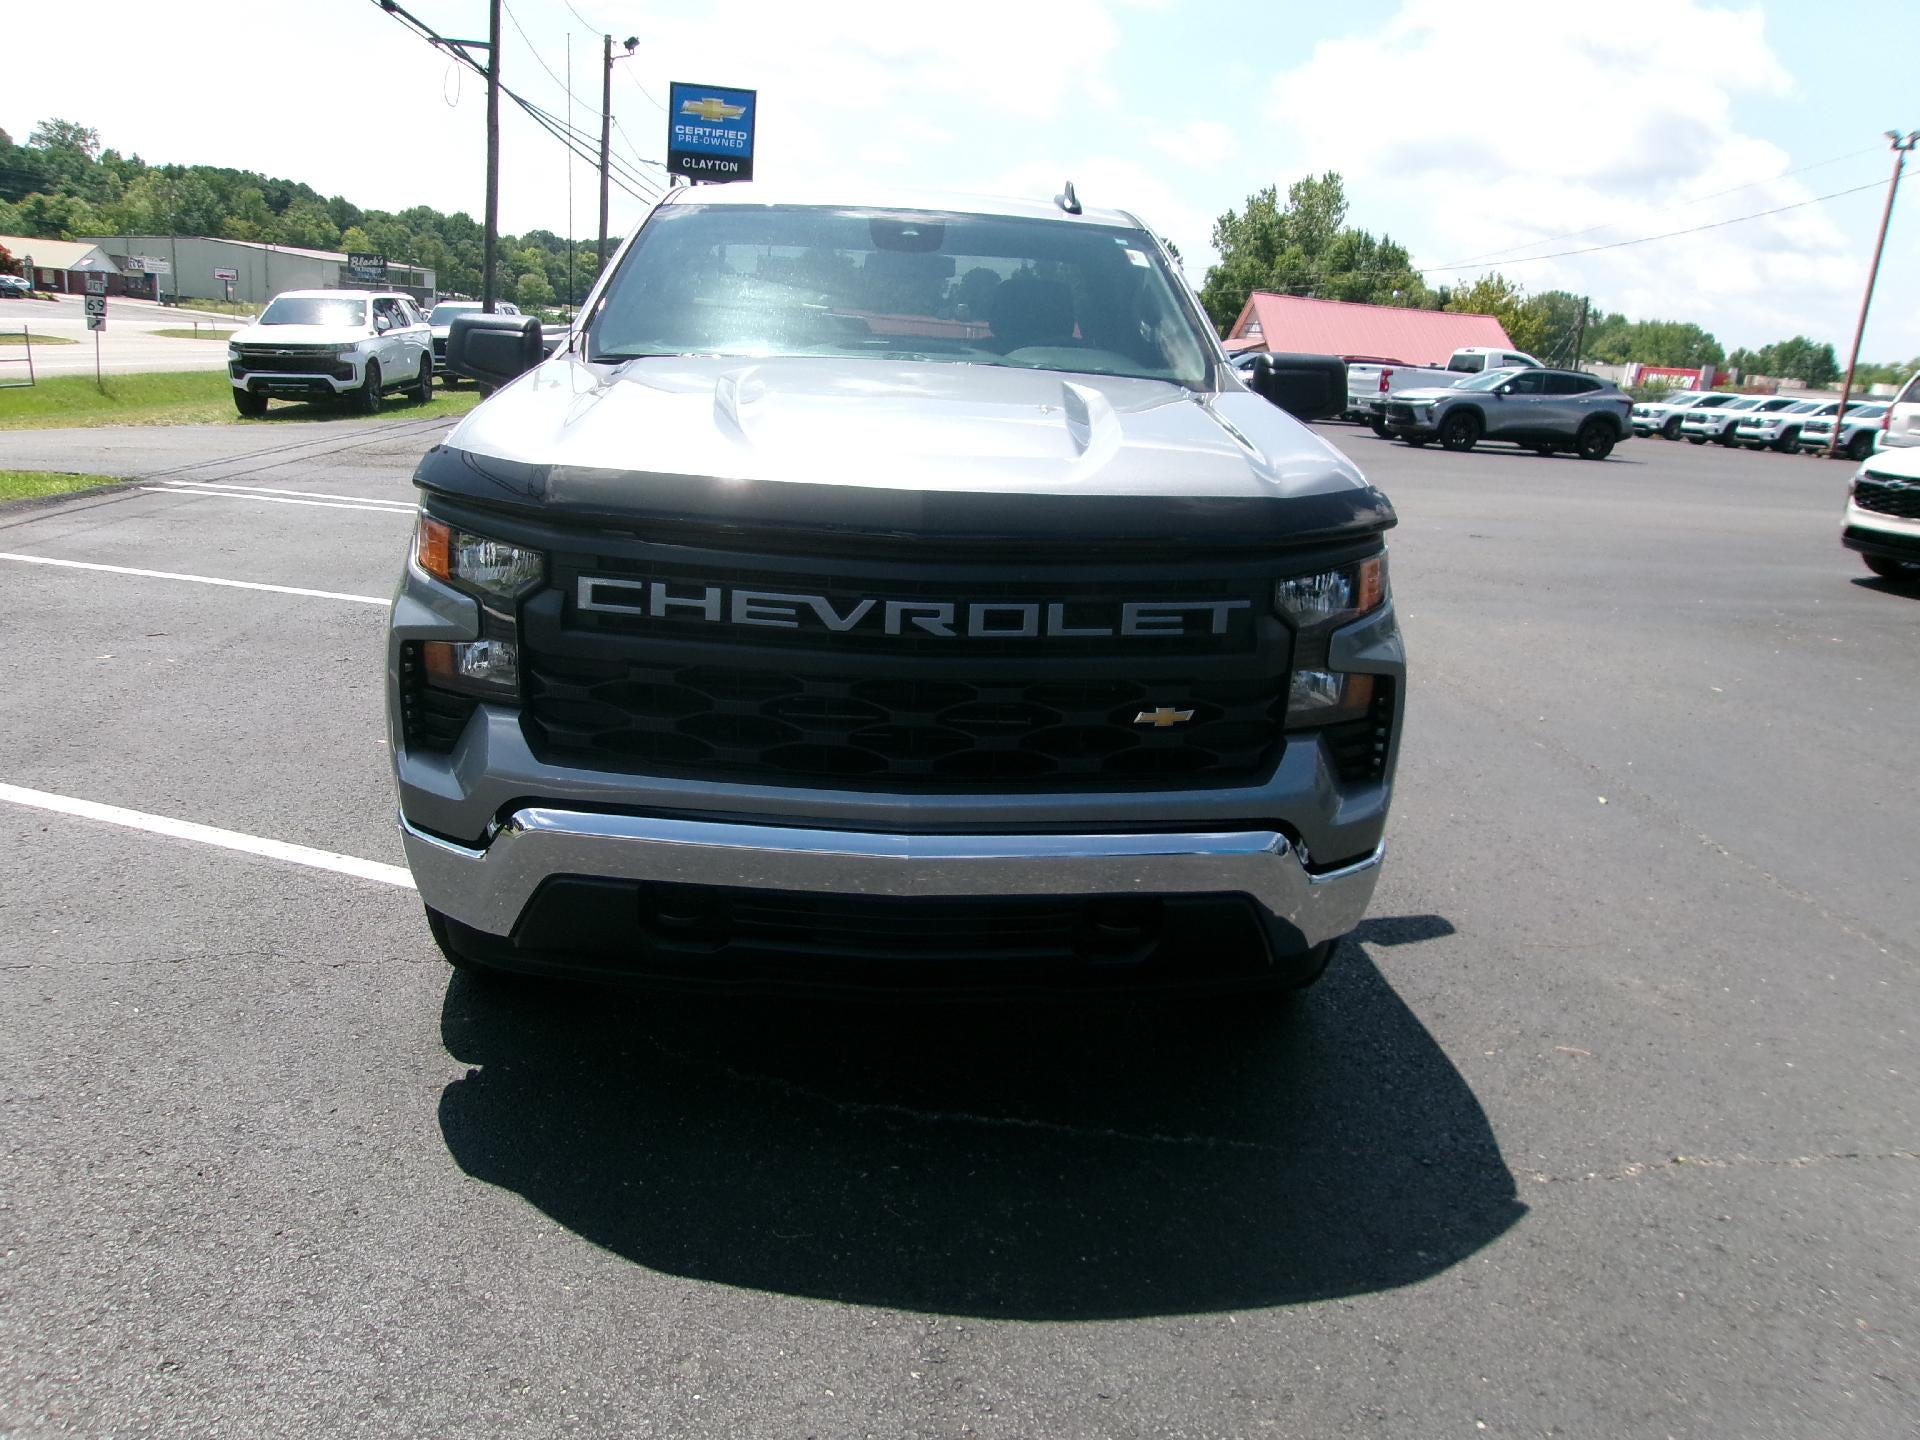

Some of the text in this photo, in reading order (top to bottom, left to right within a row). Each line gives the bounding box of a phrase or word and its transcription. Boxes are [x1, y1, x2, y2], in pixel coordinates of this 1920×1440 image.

[675, 125, 747, 140] CERTIFIED
[678, 134, 744, 148] PRE-OWNED
[682, 157, 738, 172] CLAYTON
[87, 299, 105, 311] 69
[576, 575, 1252, 639] CHEVROLET
